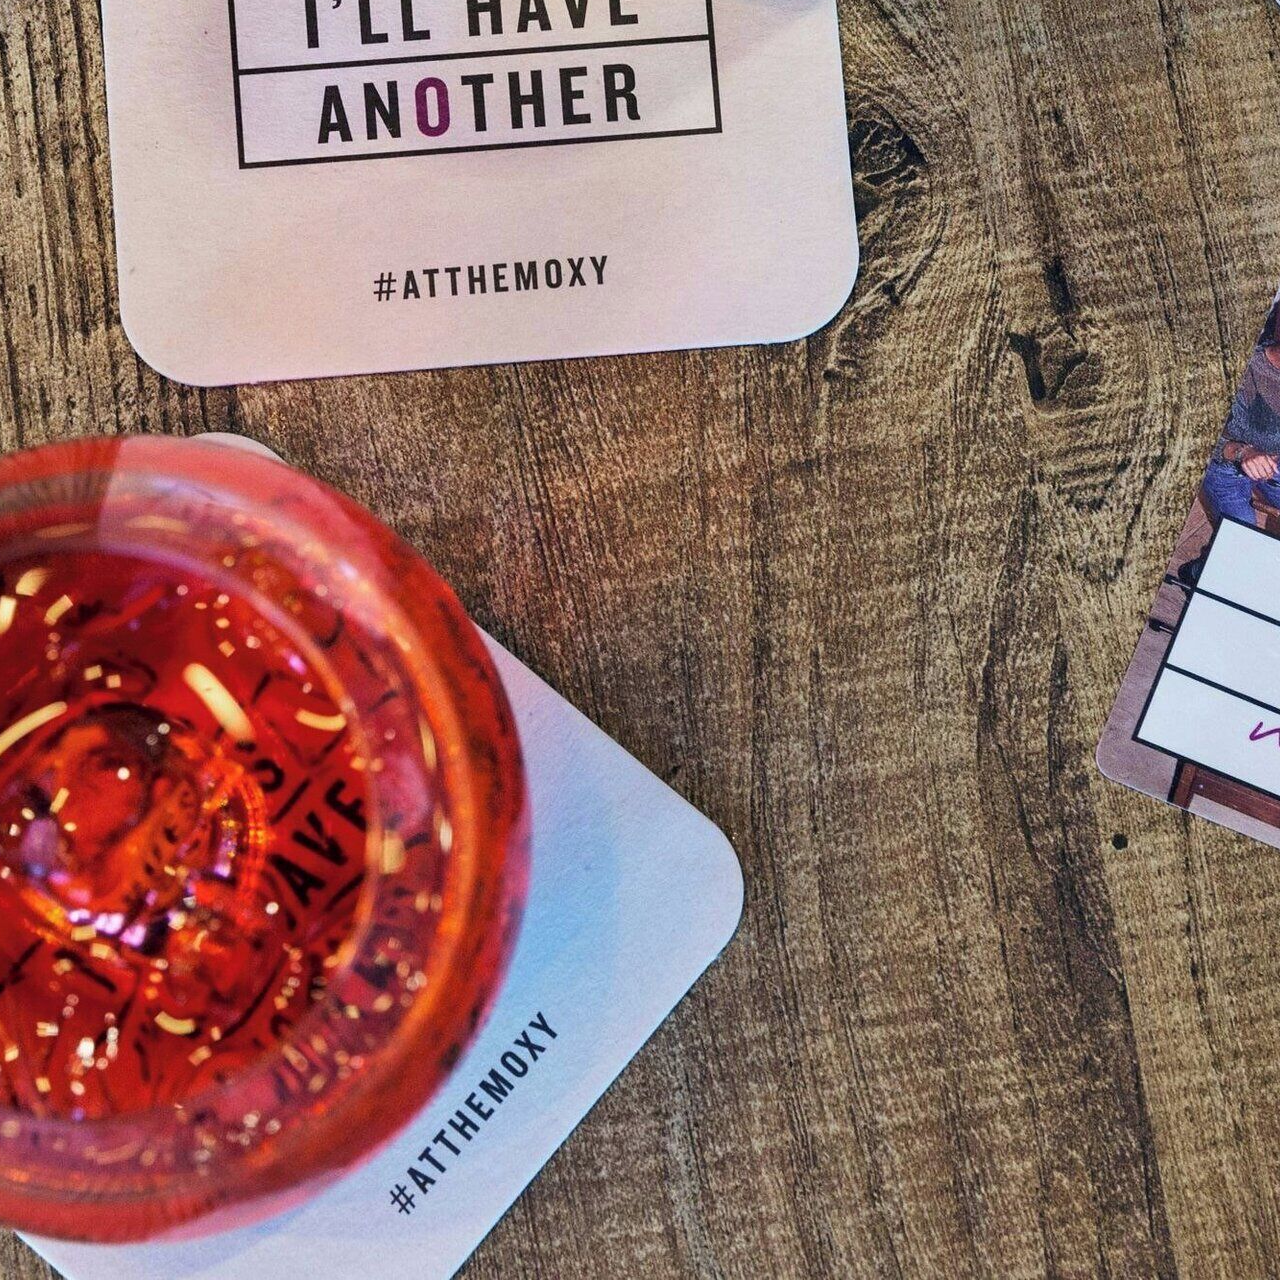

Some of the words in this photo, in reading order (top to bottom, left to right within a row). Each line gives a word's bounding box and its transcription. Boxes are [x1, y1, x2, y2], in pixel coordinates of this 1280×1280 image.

[317, 63, 641, 144] ANOTHER
[373, 255, 609, 302] #ATTHEMOXY
[389, 1011, 558, 1216] #ATTHEMOXY
